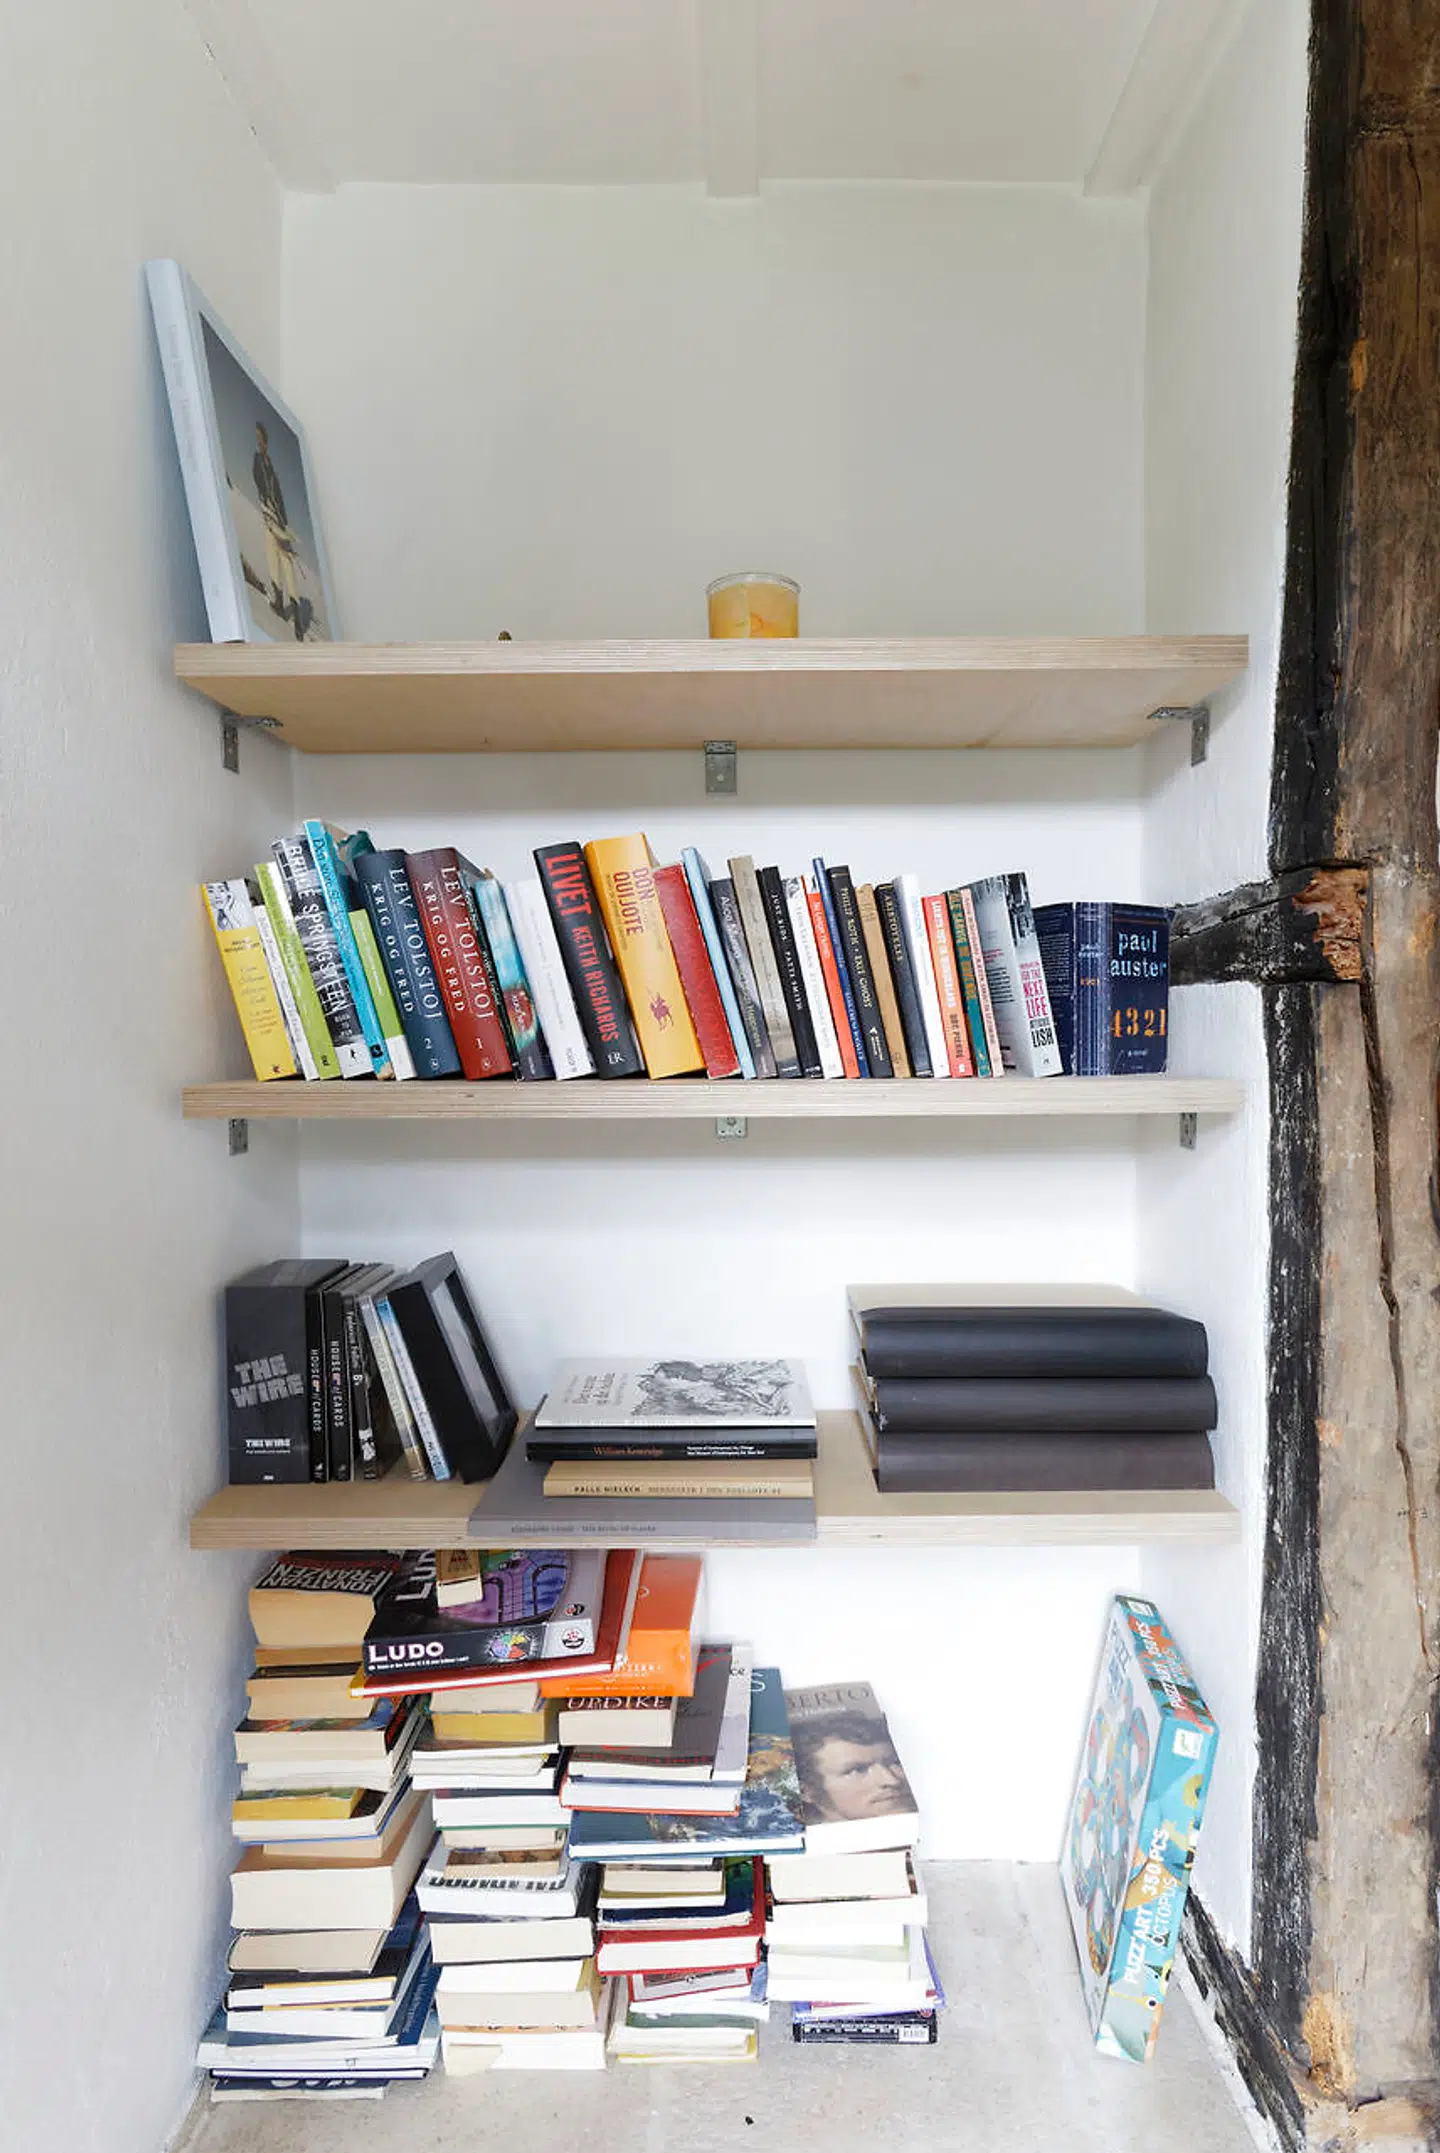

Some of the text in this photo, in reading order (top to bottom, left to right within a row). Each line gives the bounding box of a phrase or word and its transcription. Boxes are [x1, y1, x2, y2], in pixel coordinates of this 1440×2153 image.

[545, 852, 592, 917] LIVET
[632, 866, 654, 902] DON
[613, 870, 644, 937] QUIJOTE
[840, 887, 854, 916] PHILIP
[288, 845, 315, 902] BRUCE
[302, 903, 348, 1014] SPRINGSTEEN
[389, 867, 443, 1020] LEV TOLSTOJ
[441, 866, 466, 908] LEV
[455, 917, 494, 1020] TOLSTOJ
[846, 917, 859, 944] ROTH
[882, 894, 904, 963] ARISTOTELES
[1118, 930, 1158, 956] paul
[371, 883, 392, 926] KRIG
[386, 935, 399, 959] OG
[393, 967, 414, 1013] FRED
[422, 881, 465, 1013] KRIG OG FRED
[572, 926, 595, 968] KEITH
[770, 893, 803, 1011] JUST KIDS PATTI SMITH
[855, 954, 867, 977] EXIT
[1110, 957, 1167, 978] auster
[859, 977, 873, 1008] GHOST
[1023, 979, 1045, 998] NEXT
[583, 969, 620, 1043] RICHARDS
[1026, 996, 1048, 1019] LIFE
[422, 1037, 433, 1050] 2
[475, 1038, 483, 1050] 1
[1031, 1028, 1054, 1048] LISH
[234, 1353, 288, 1385] THE
[311, 1348, 321, 1379] HOUSE
[330, 1340, 342, 1373] HOUSE
[230, 1373, 304, 1408] WIRE
[312, 1400, 323, 1433] CARDS
[333, 1394, 344, 1428] CARDS
[574, 1486, 600, 1494] PALLE
[261, 1574, 374, 1593] JONATHAN
[274, 1562, 386, 1586] FRANZEN
[367, 1641, 444, 1663] LUDO
[1150, 1827, 1170, 1863] PCS
[1142, 1861, 1163, 1897] 350
[1150, 1874, 1178, 1947] OCTOPUS
